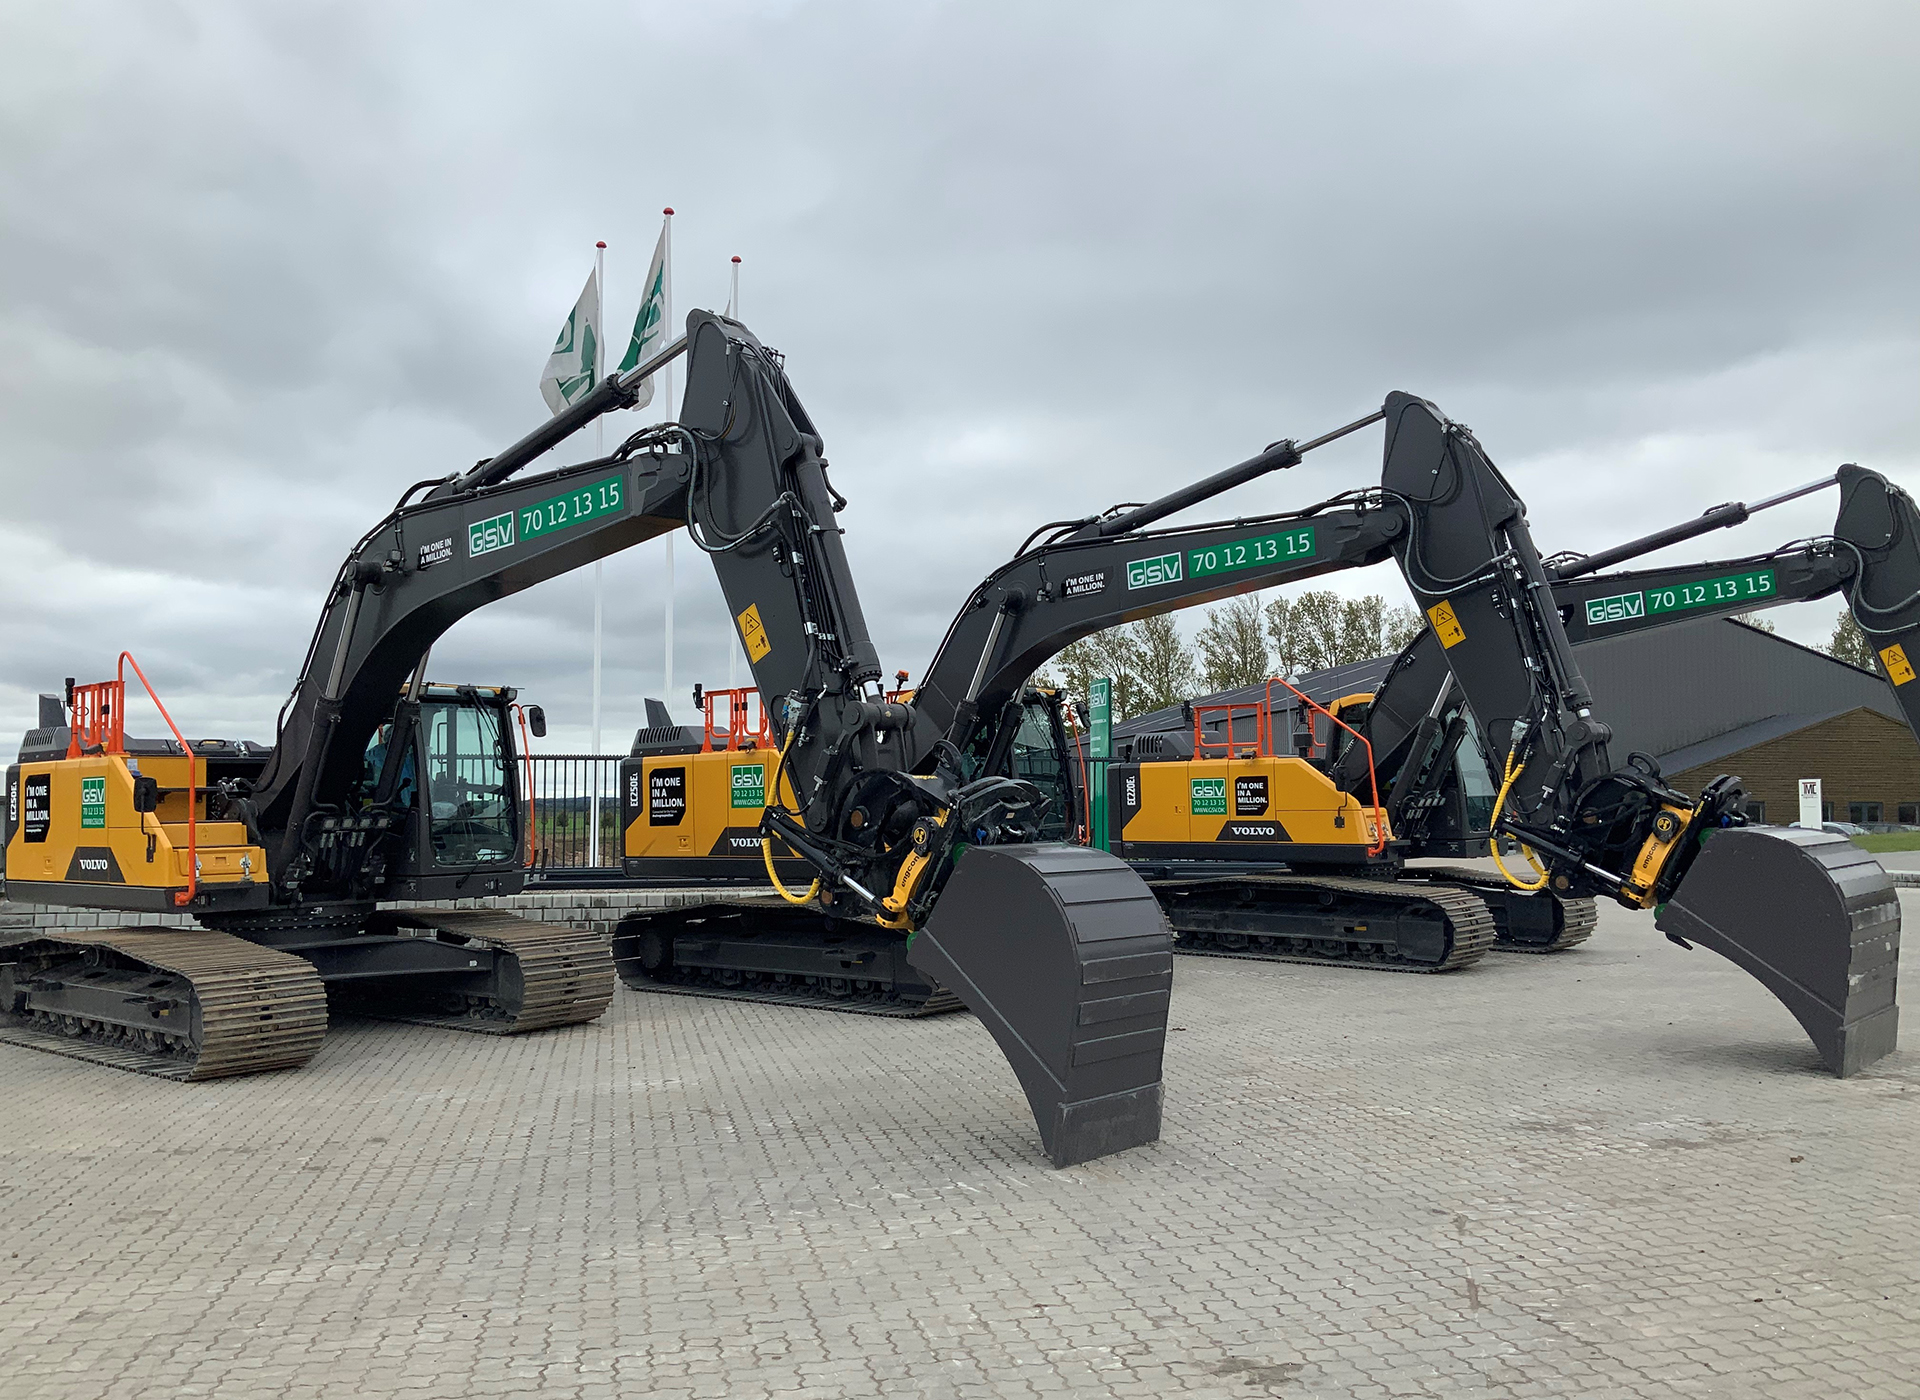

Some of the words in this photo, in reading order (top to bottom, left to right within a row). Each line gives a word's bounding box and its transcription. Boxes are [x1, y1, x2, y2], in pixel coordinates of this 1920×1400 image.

[522, 509, 542, 534] 70
[548, 501, 567, 526] 12
[574, 493, 592, 518] 13
[599, 482, 619, 509] 15
[470, 522, 512, 553] GSV
[420, 545, 430, 555] I'M
[431, 540, 444, 551] ONE
[445, 538, 452, 547] IN
[1193, 552, 1216, 572] 70
[1224, 546, 1246, 566] 12
[1254, 540, 1278, 560] 13
[1286, 533, 1310, 554] 15
[420, 556, 425, 564] A
[426, 548, 453, 562] MILLION.
[1130, 561, 1179, 586] GSV
[1066, 578, 1077, 587] I'M
[1078, 575, 1095, 584] ONE
[1073, 581, 1105, 593] MILLION.
[1651, 592, 1675, 610] 70
[1684, 586, 1706, 604] 12
[1714, 581, 1737, 599] 13
[1746, 575, 1770, 594] 15
[1589, 600, 1640, 622] GSV
[652, 777, 663, 787] I'M
[664, 777, 681, 786] ONE
[733, 774, 762, 786] GSV
[26, 785, 35, 797] I'M
[36, 786, 47, 796] ONE
[83, 788, 104, 802] GSV
[630, 772, 638, 807] EC250EL
[652, 789, 660, 797] IN
[661, 788, 667, 797] A
[1127, 776, 1135, 806] EC220EL
[1193, 786, 1224, 796] GSV
[26, 799, 33, 808] IN
[33, 799, 37, 808] A
[652, 798, 684, 808] MILLION.
[26, 810, 49, 821] MILLION.
[1231, 827, 1275, 836] VOLVO
[730, 838, 763, 847] VOLV
[1642, 842, 1659, 868] engcon
[80, 860, 107, 870] VOLVO
[901, 856, 919, 888] engcon
